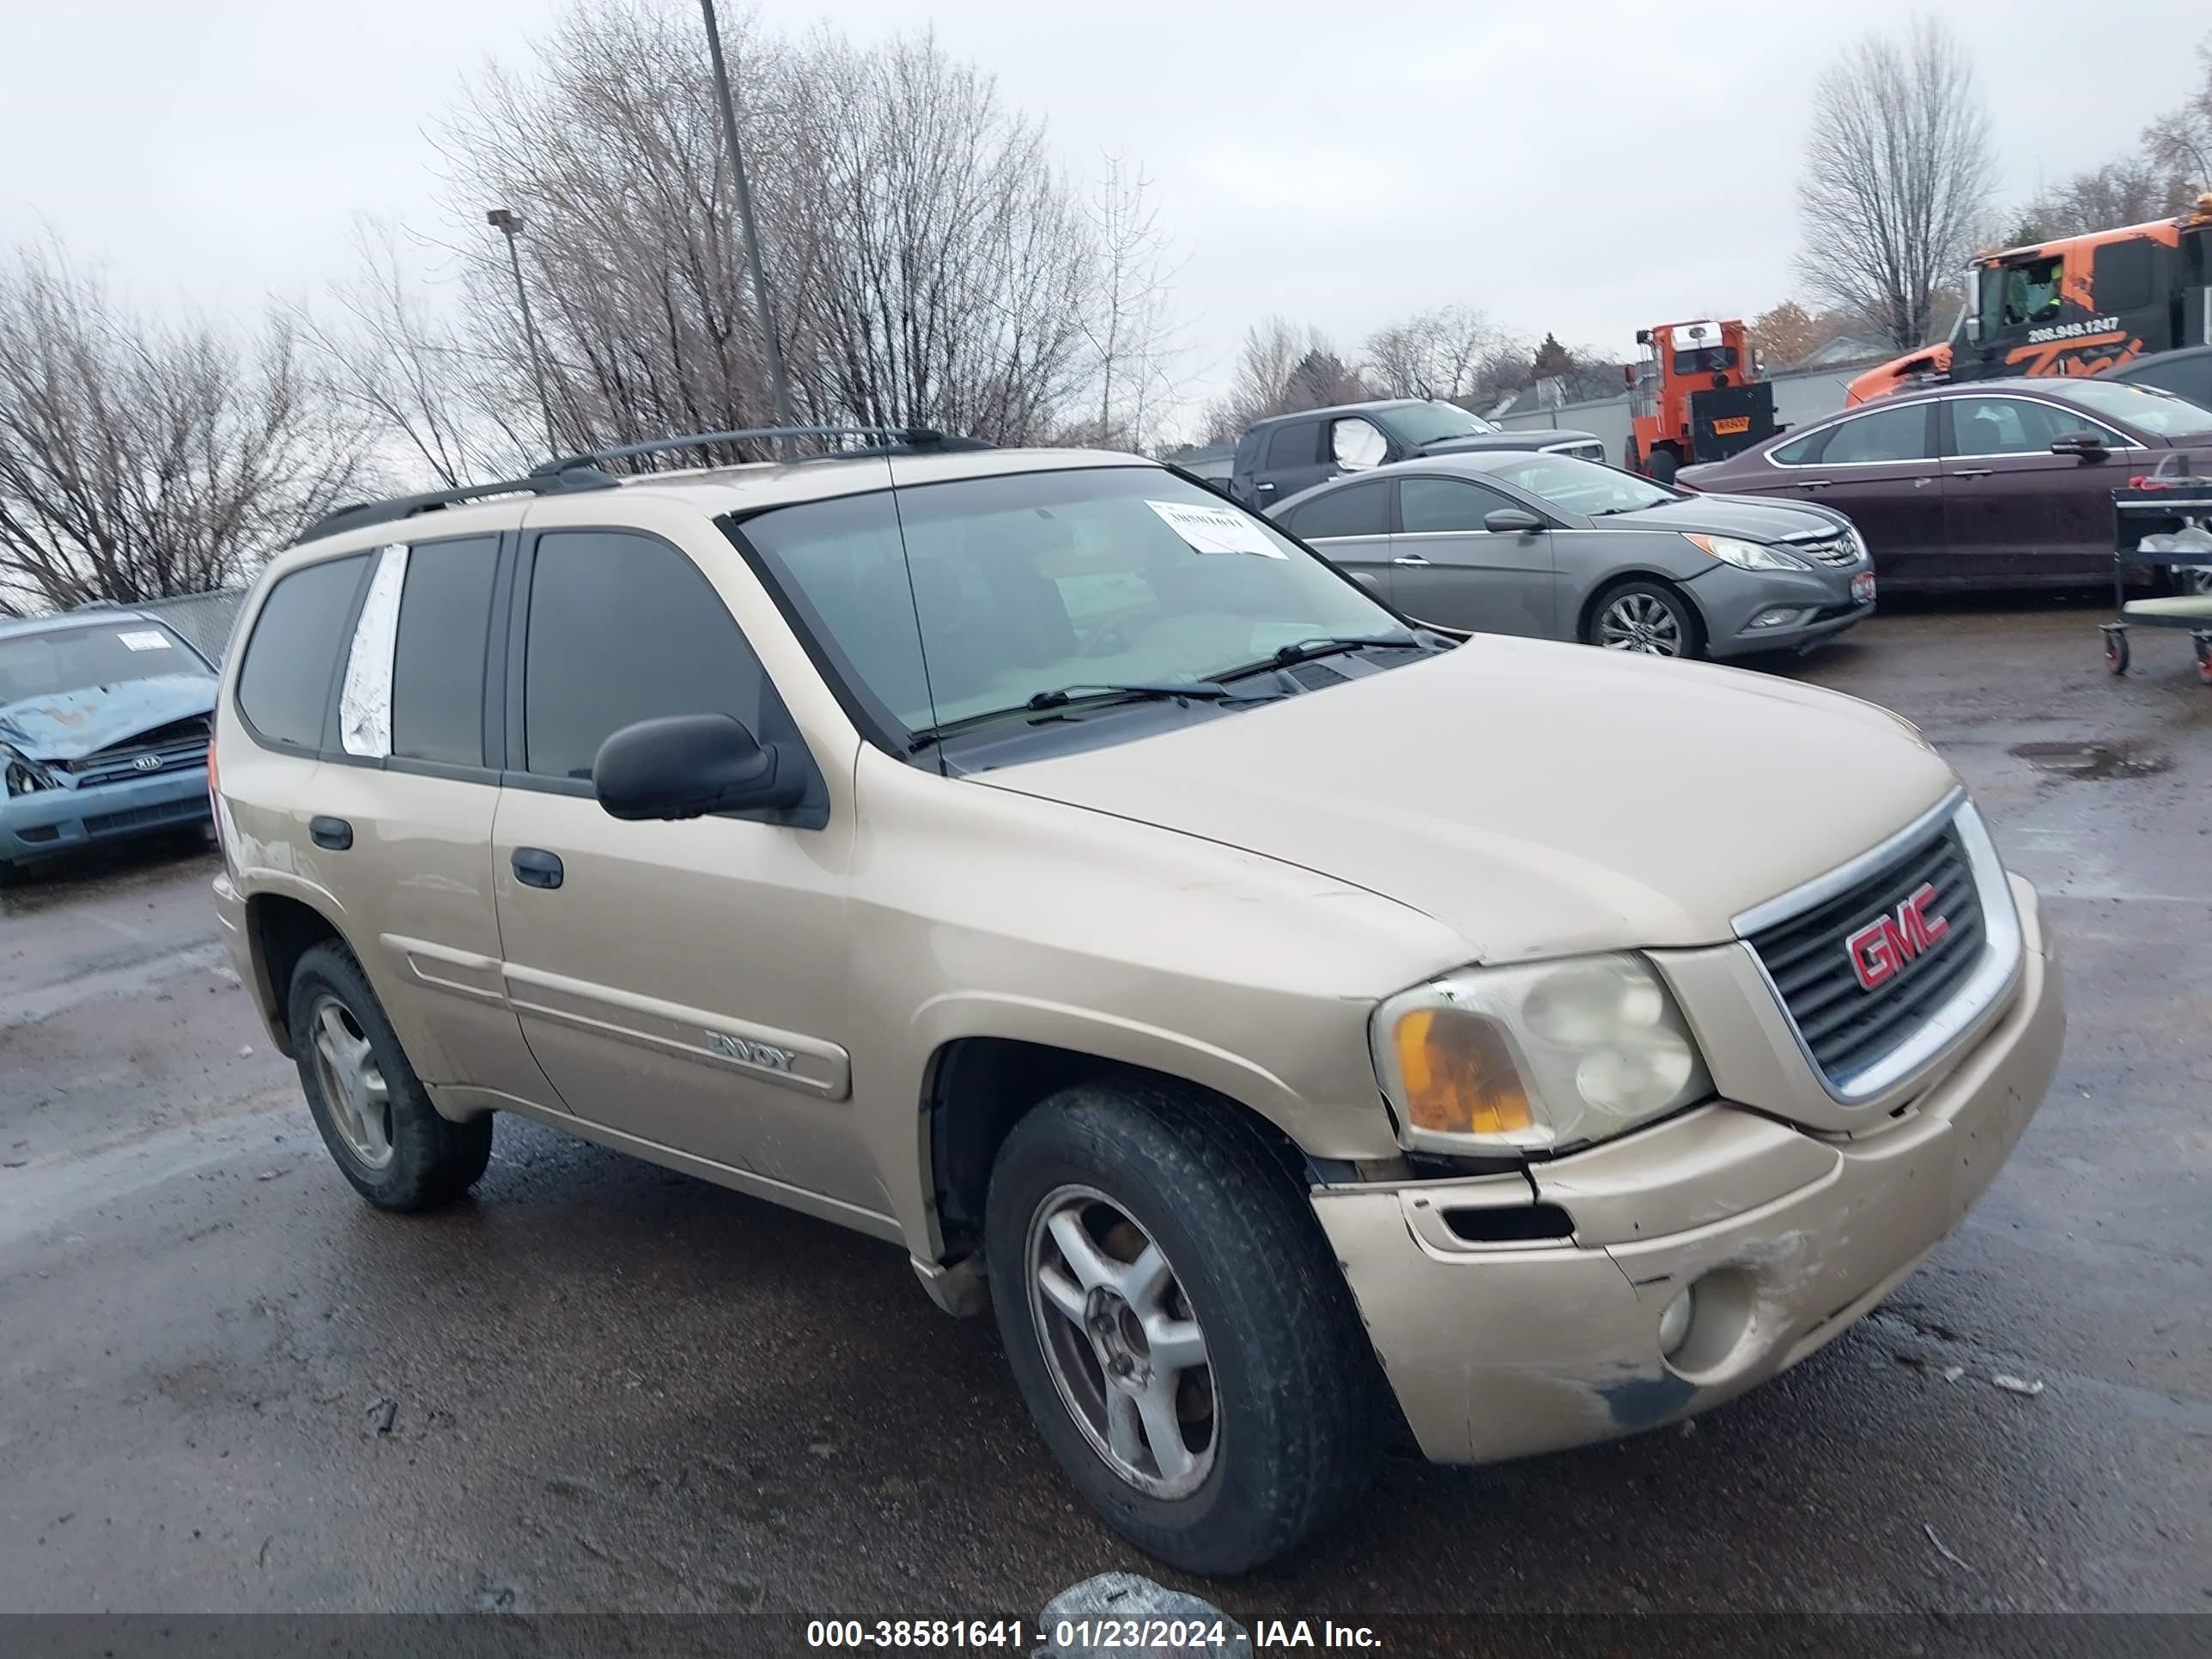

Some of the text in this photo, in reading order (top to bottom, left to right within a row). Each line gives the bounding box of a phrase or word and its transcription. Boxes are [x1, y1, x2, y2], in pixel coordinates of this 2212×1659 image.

[136, 756, 160, 769] KIA
[1845, 881, 1950, 992] GMC
[704, 1030, 797, 1072] ENVOY
